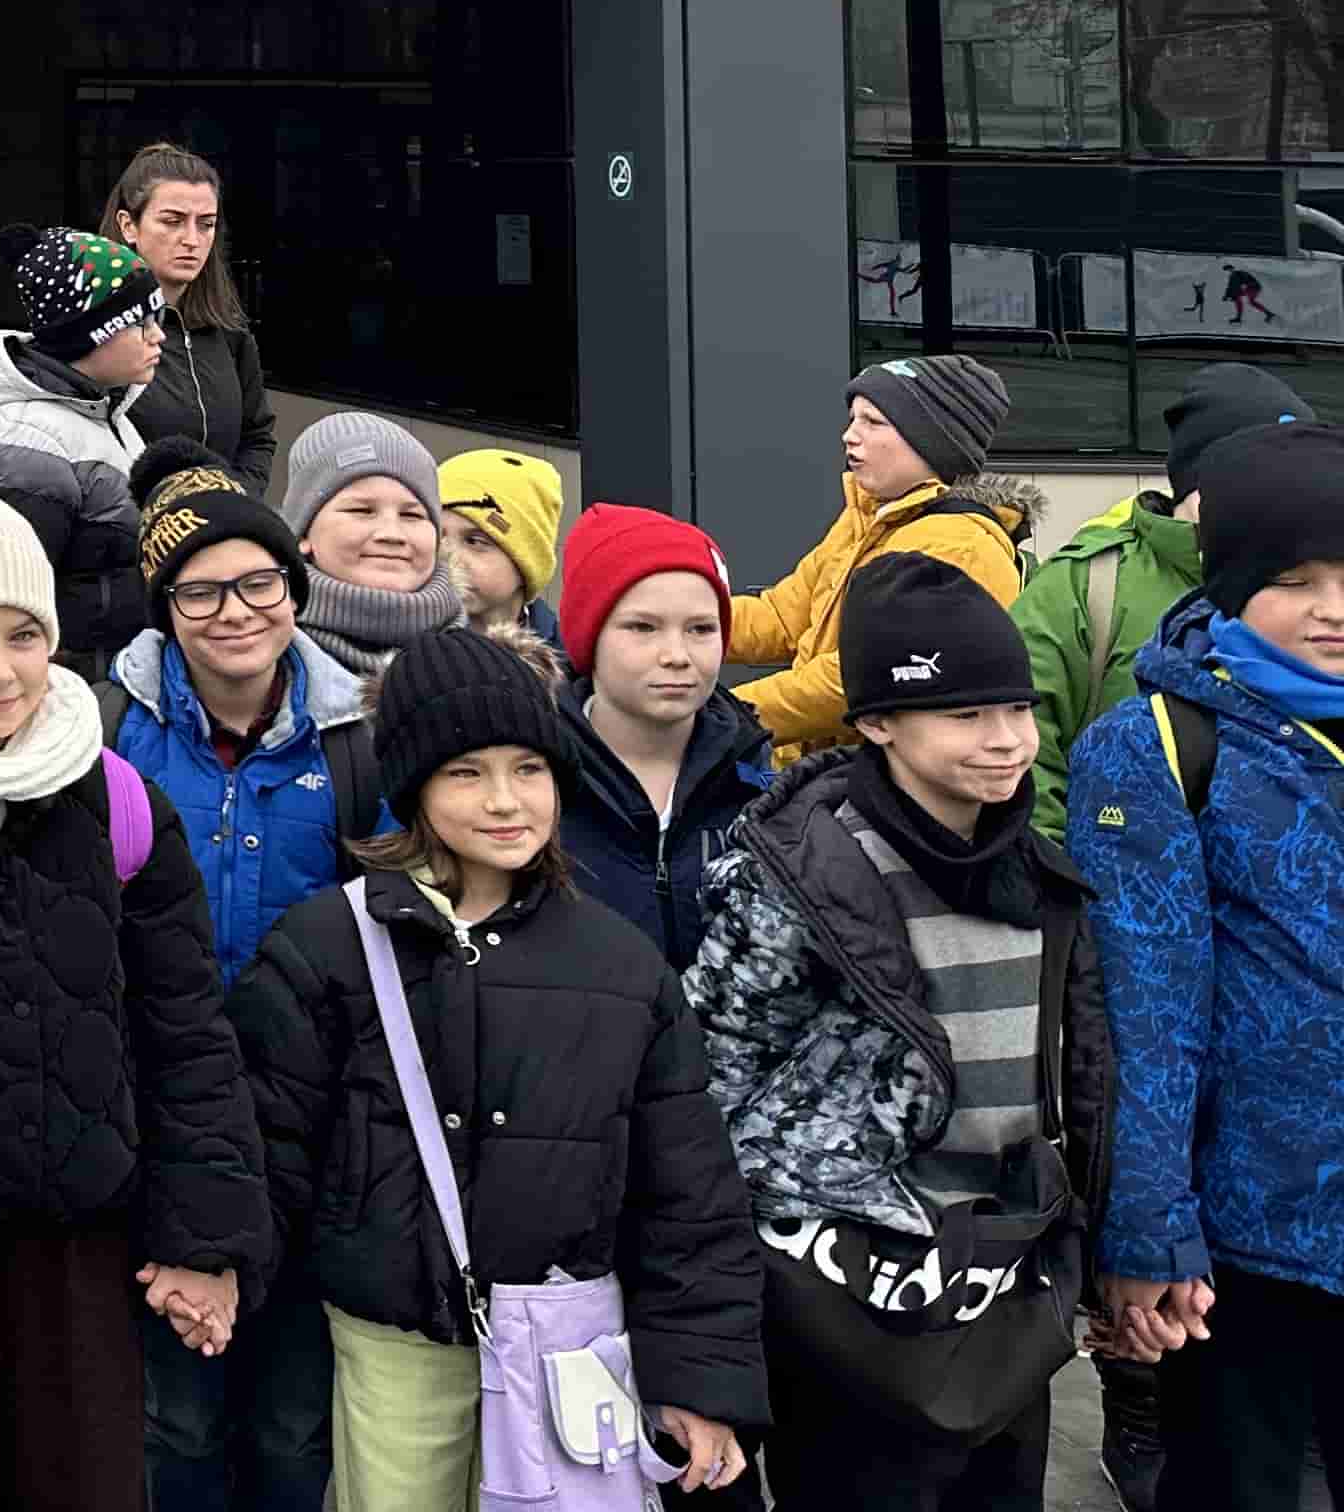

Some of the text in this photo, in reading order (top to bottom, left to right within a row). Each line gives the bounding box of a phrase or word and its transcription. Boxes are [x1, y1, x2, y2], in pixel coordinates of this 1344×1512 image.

[89, 303, 144, 345] MERRY
[891, 665, 932, 682] PUMA
[295, 773, 327, 791] 4F
